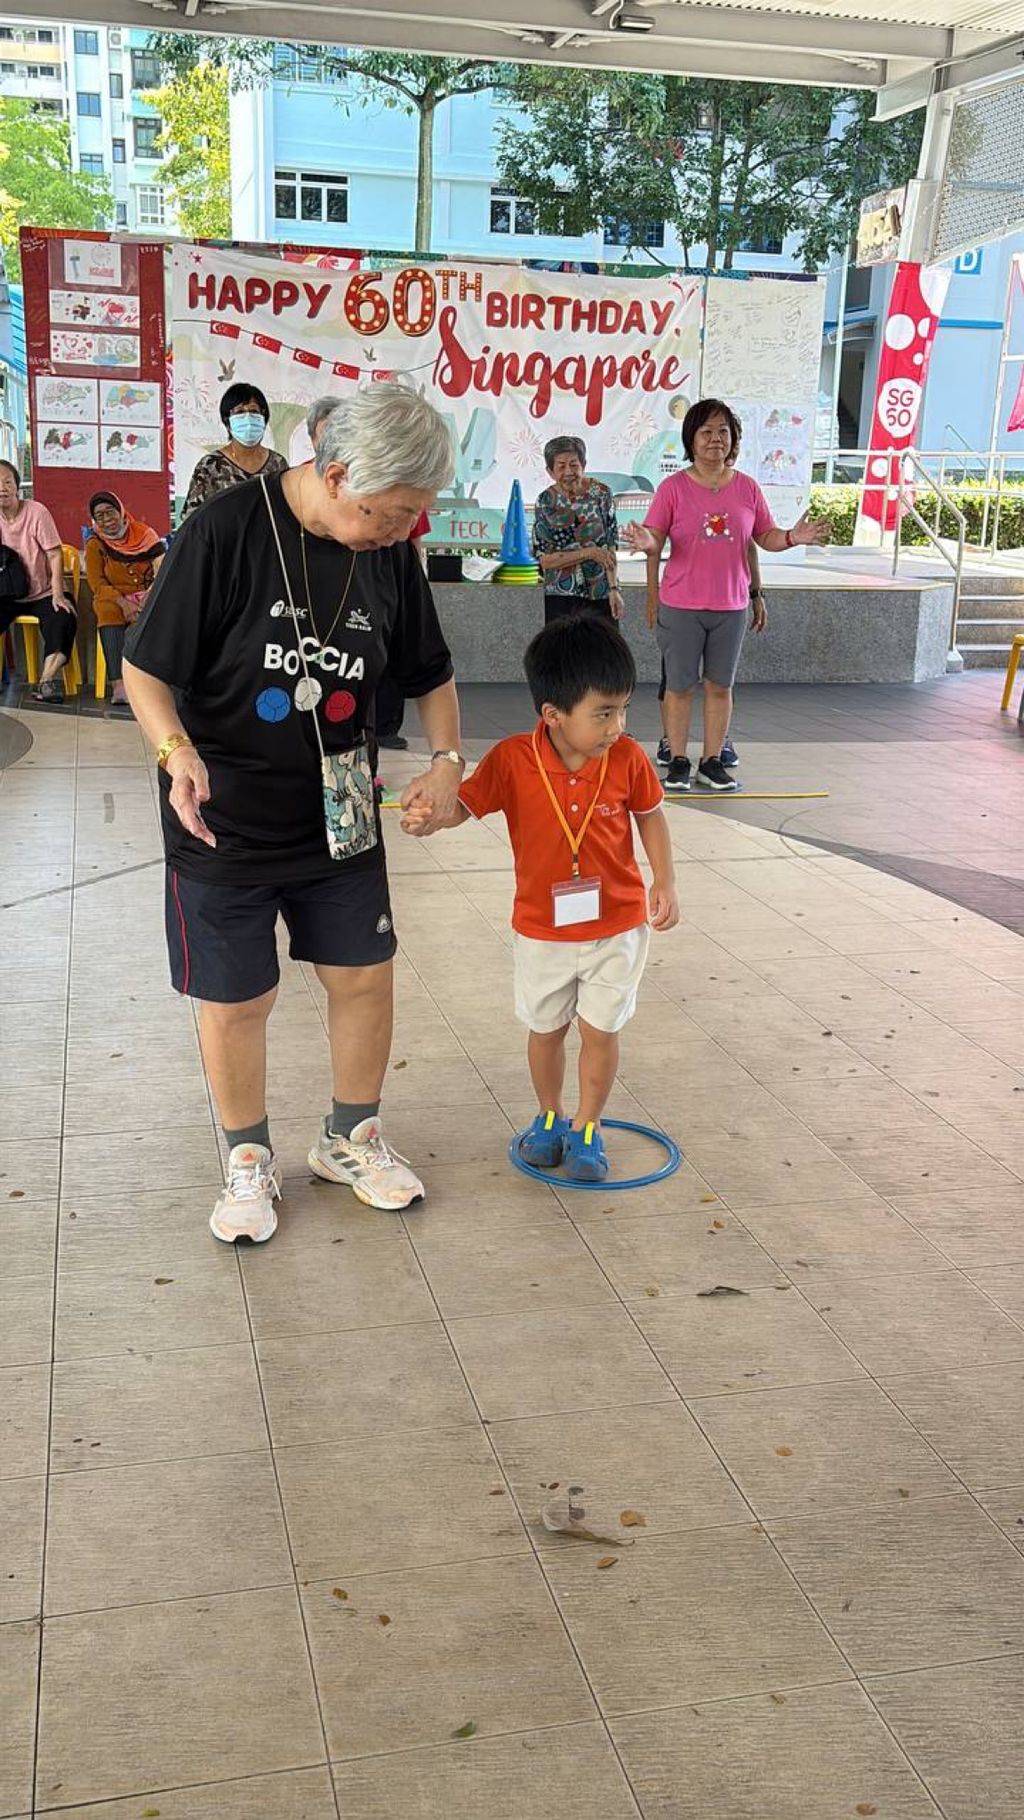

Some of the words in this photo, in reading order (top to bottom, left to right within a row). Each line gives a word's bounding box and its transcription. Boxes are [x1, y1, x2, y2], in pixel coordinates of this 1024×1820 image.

[960, 249, 978, 271] D
[188, 272, 332, 319] HAPPY
[433, 305, 690, 426] Singapore
[887, 388, 914, 407] SG
[886, 408, 911, 427] 60
[450, 520, 489, 539] TECK
[263, 636, 365, 681] BOCCIA
